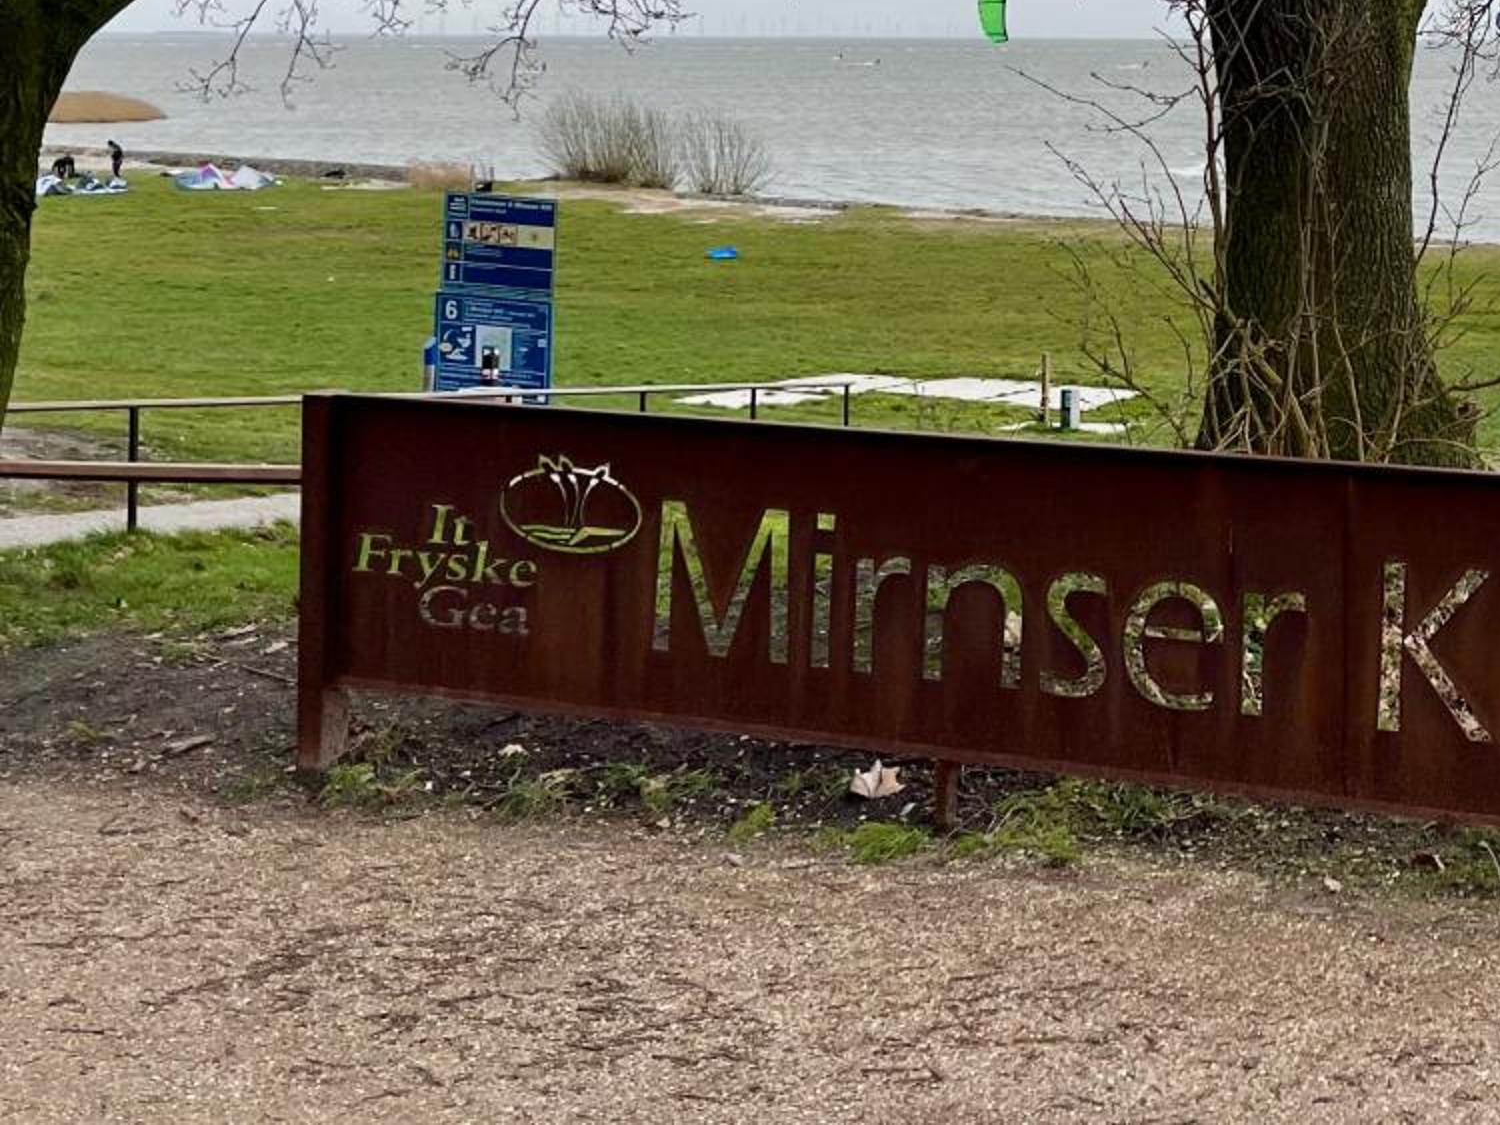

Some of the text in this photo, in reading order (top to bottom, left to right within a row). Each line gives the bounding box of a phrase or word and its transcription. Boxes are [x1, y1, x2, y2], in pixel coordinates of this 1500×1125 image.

[427, 503, 473, 546] It
[352, 532, 538, 589] Fryske
[418, 584, 529, 635] Gea
[651, 499, 1306, 716] Mirnser
